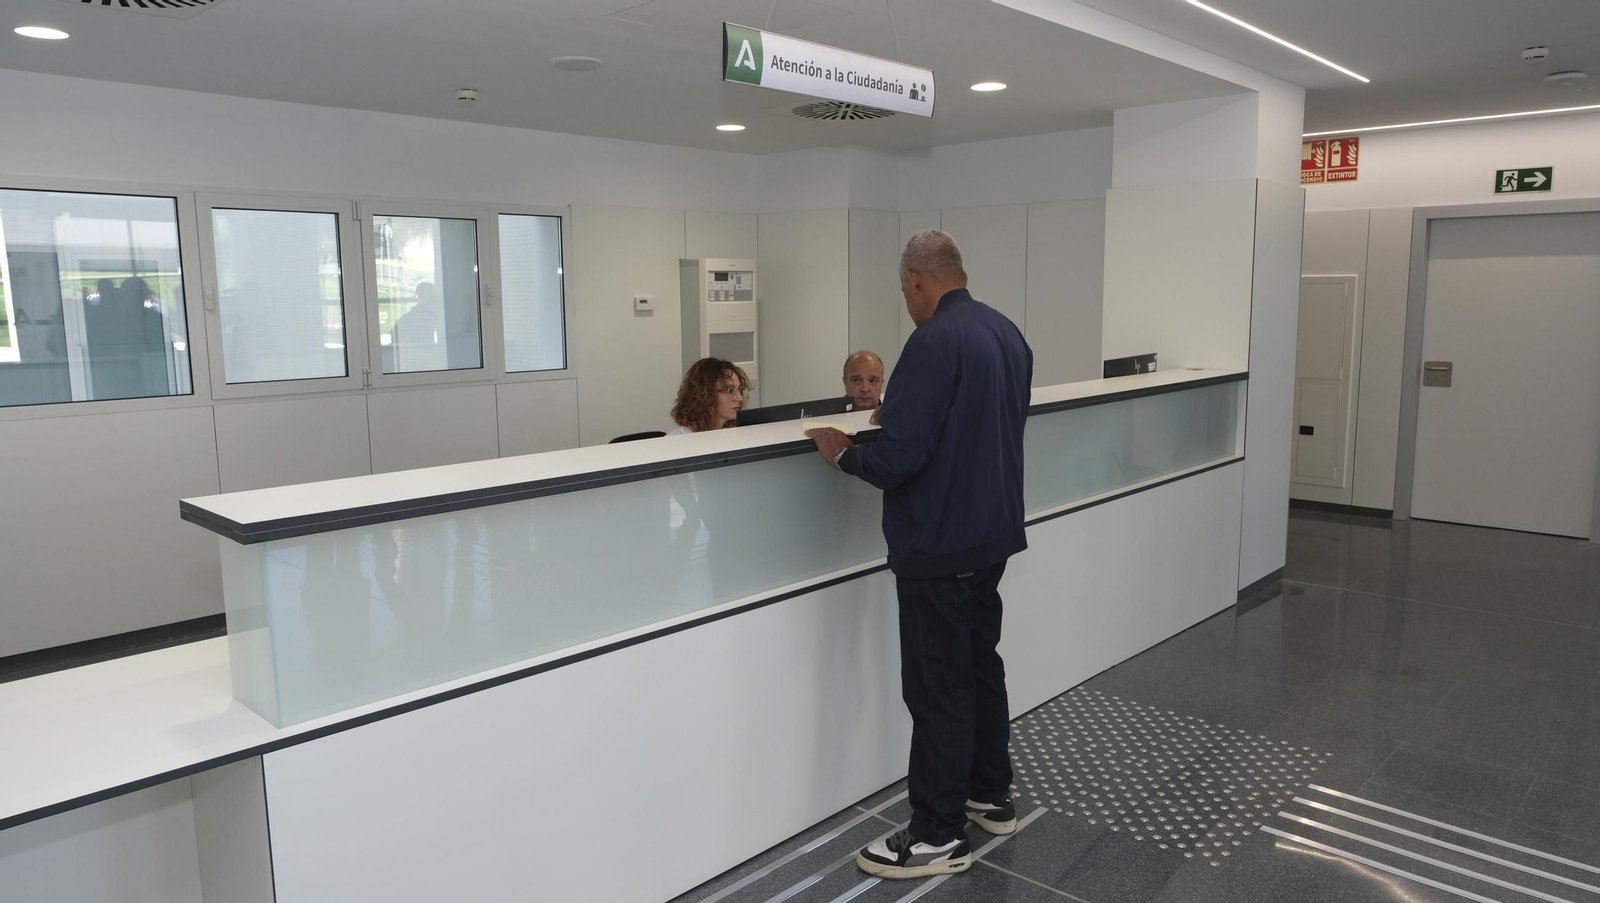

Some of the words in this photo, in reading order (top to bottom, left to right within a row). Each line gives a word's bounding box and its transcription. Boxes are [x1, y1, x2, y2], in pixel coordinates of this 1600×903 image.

[734, 39, 756, 71] A
[770, 54, 823, 78] Atención
[825, 69, 832, 80] a
[834, 67, 844, 82] la
[846, 71, 904, 95] Ciudadanía
[1328, 171, 1357, 179] EXTINTOR
